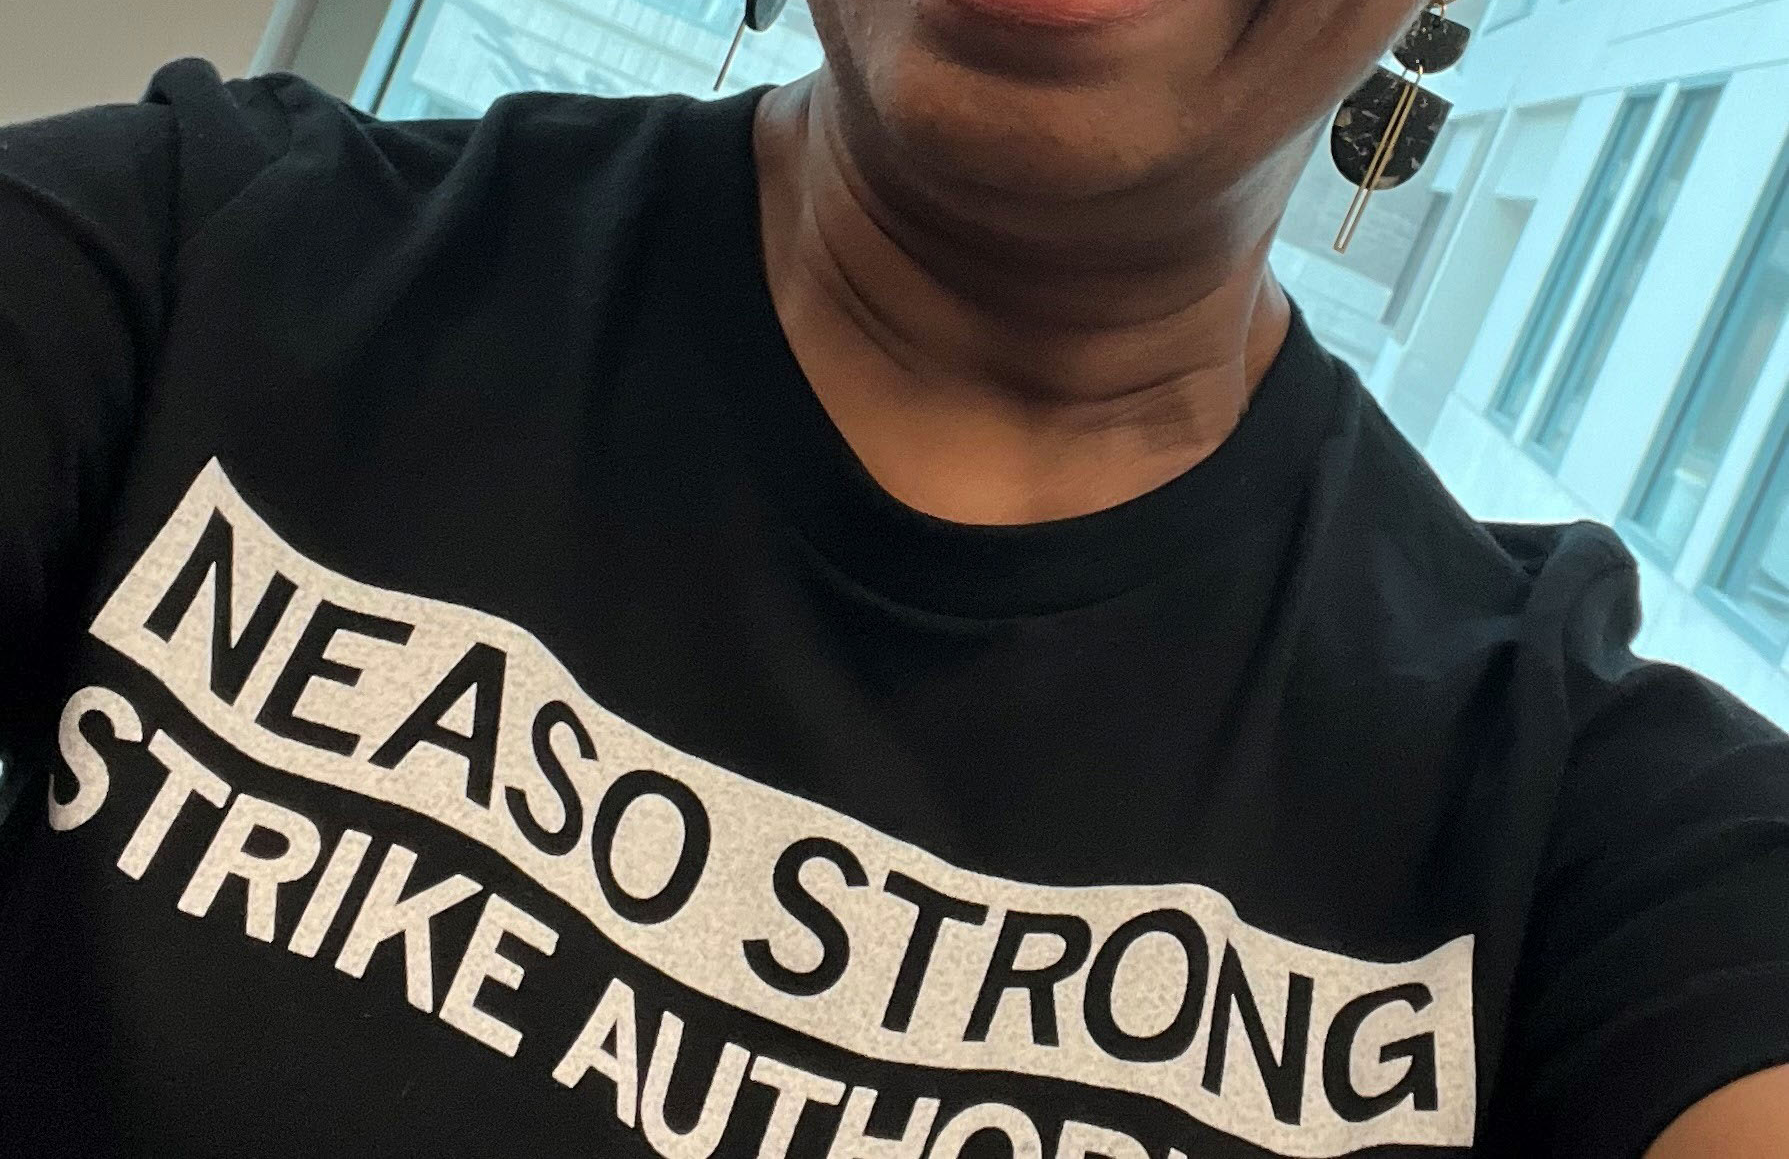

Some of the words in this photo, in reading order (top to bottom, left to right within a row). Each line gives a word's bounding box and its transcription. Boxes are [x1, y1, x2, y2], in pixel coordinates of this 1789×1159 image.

[48, 686, 559, 1058] STRIKE
[142, 507, 710, 925] NEASO
[743, 837, 1438, 1126] STRONG
